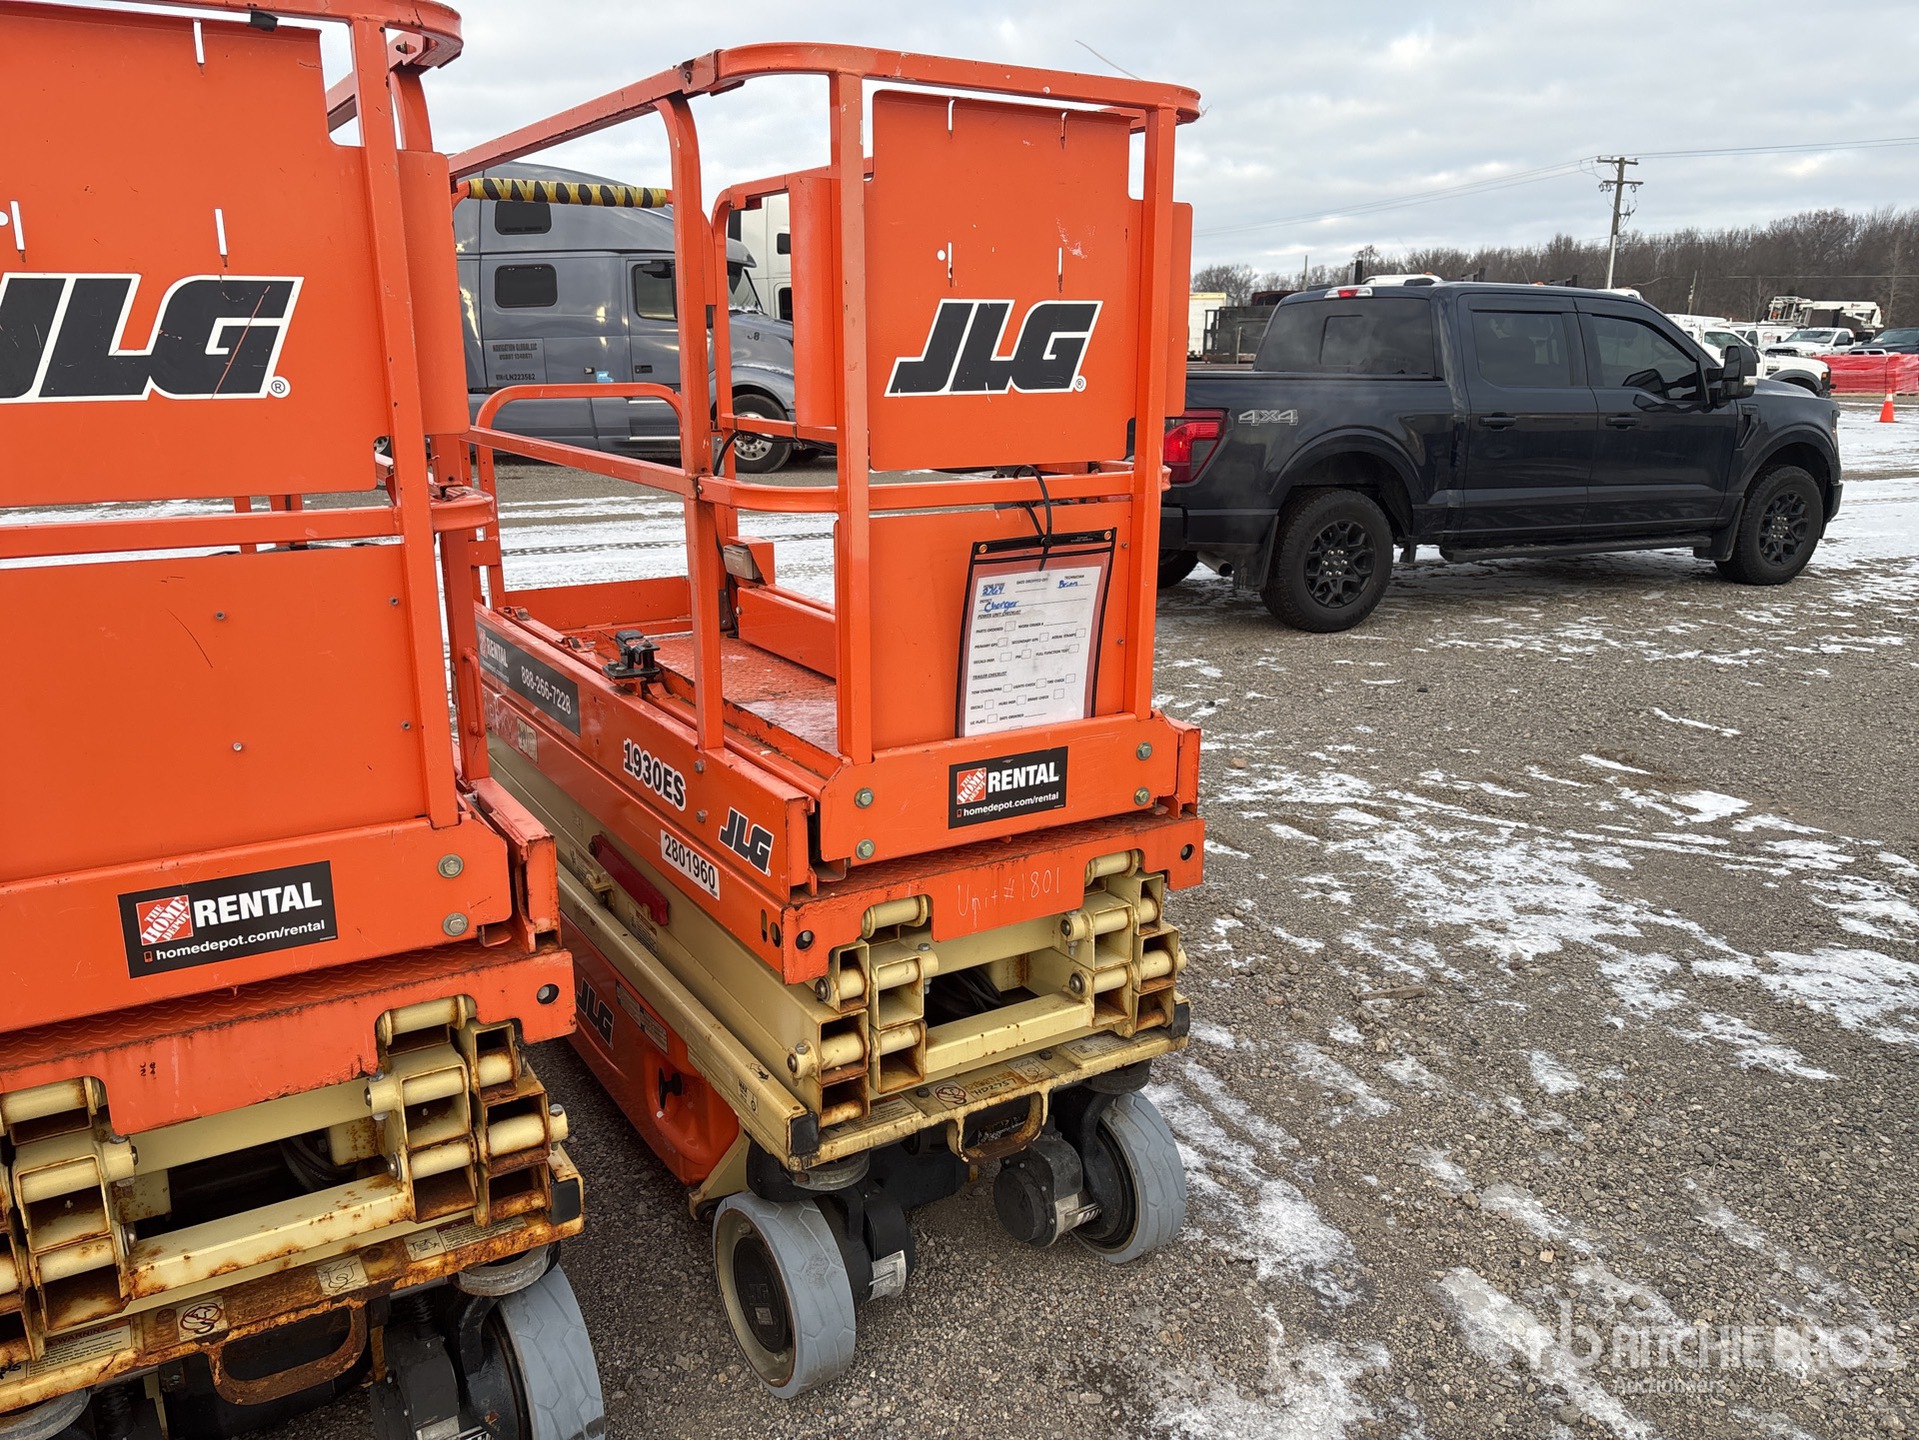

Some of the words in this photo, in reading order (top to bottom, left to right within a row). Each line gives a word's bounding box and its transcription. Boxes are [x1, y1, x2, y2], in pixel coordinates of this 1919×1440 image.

[884, 299, 1103, 397] JLG
[487, 637, 508, 668] RENTAL
[521, 666, 572, 714] 888-266-7228
[623, 739, 686, 810] 1930ES
[957, 768, 986, 803] HOME
[961, 774, 972, 788] THE
[969, 782, 986, 802] DEPOT
[988, 762, 1059, 793] RENTAL
[964, 792, 1059, 816] homedepot.com/rental
[718, 806, 774, 875] JLG
[665, 834, 716, 889] 2801960
[142, 897, 189, 943] HOME
[144, 904, 163, 923] THE
[194, 882, 322, 928] RENTAL
[156, 920, 325, 961] homedepot.com/rental
[163, 913, 190, 941] DEPOT
[576, 977, 614, 1048] JLG
[58, 1325, 108, 1344] WARNING
